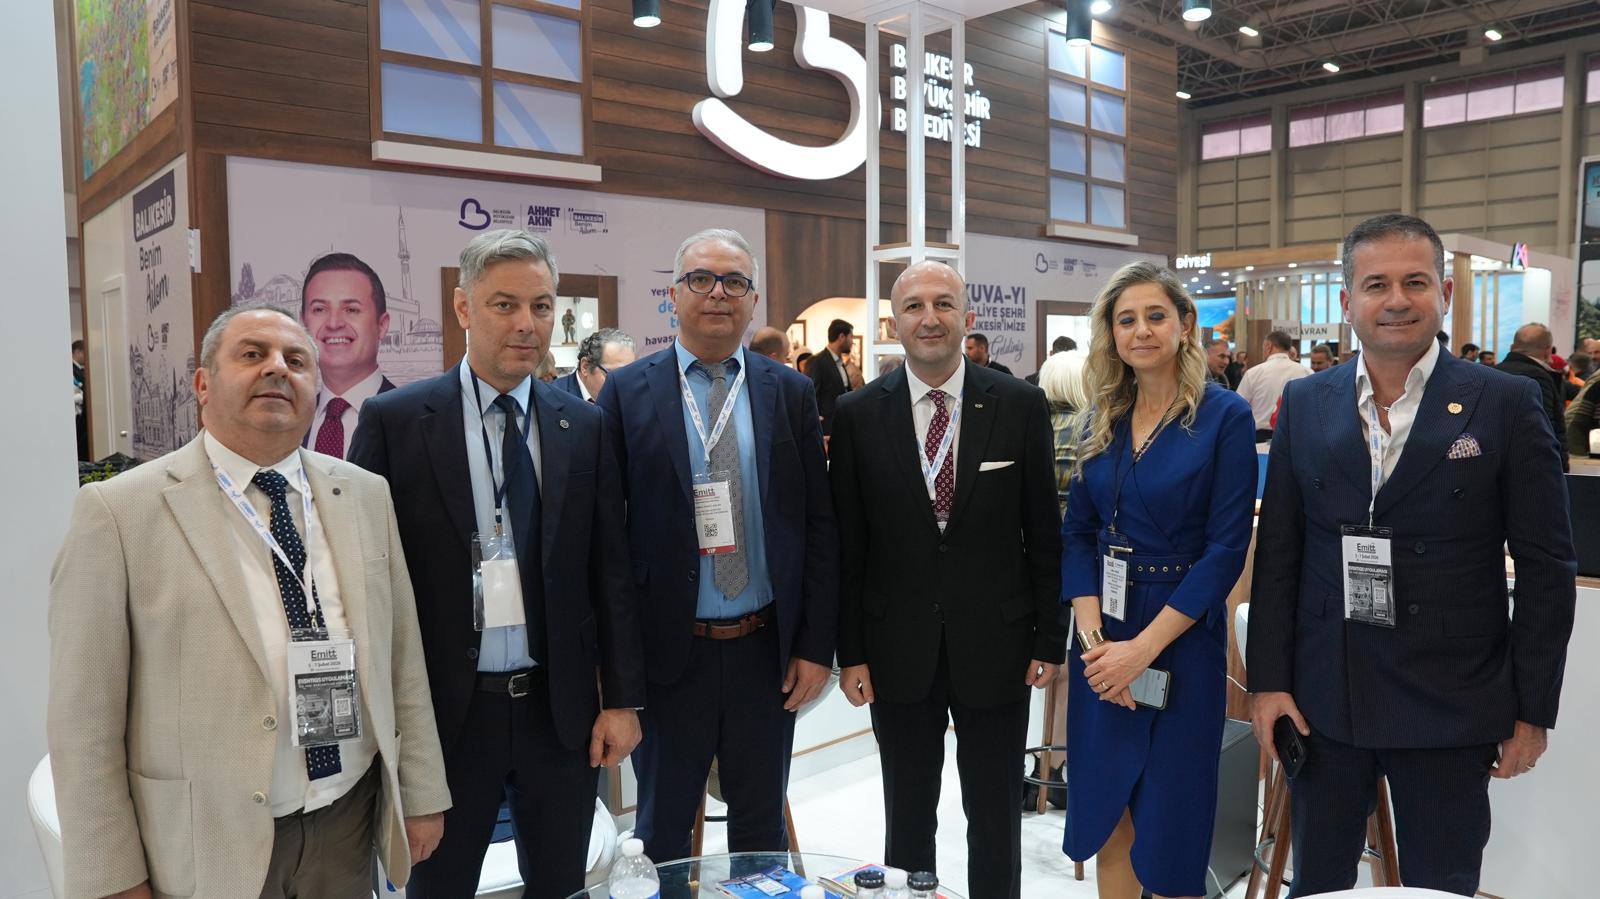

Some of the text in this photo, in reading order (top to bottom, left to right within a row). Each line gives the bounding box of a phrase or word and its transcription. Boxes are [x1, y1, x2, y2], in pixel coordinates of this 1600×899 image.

[890, 43, 974, 86] BIKER
[135, 188, 173, 238] BALIKESİR
[527, 205, 561, 217] AHMET
[527, 215, 553, 227] AKIN
[139, 241, 162, 271] Benim
[651, 286, 669, 297] Yeşi
[1300, 327, 1328, 336] AVRAN
[645, 335, 674, 346] havas
[694, 487, 715, 497] Emitt
[1356, 542, 1376, 553] Emitt
[311, 648, 337, 659] Emitt
